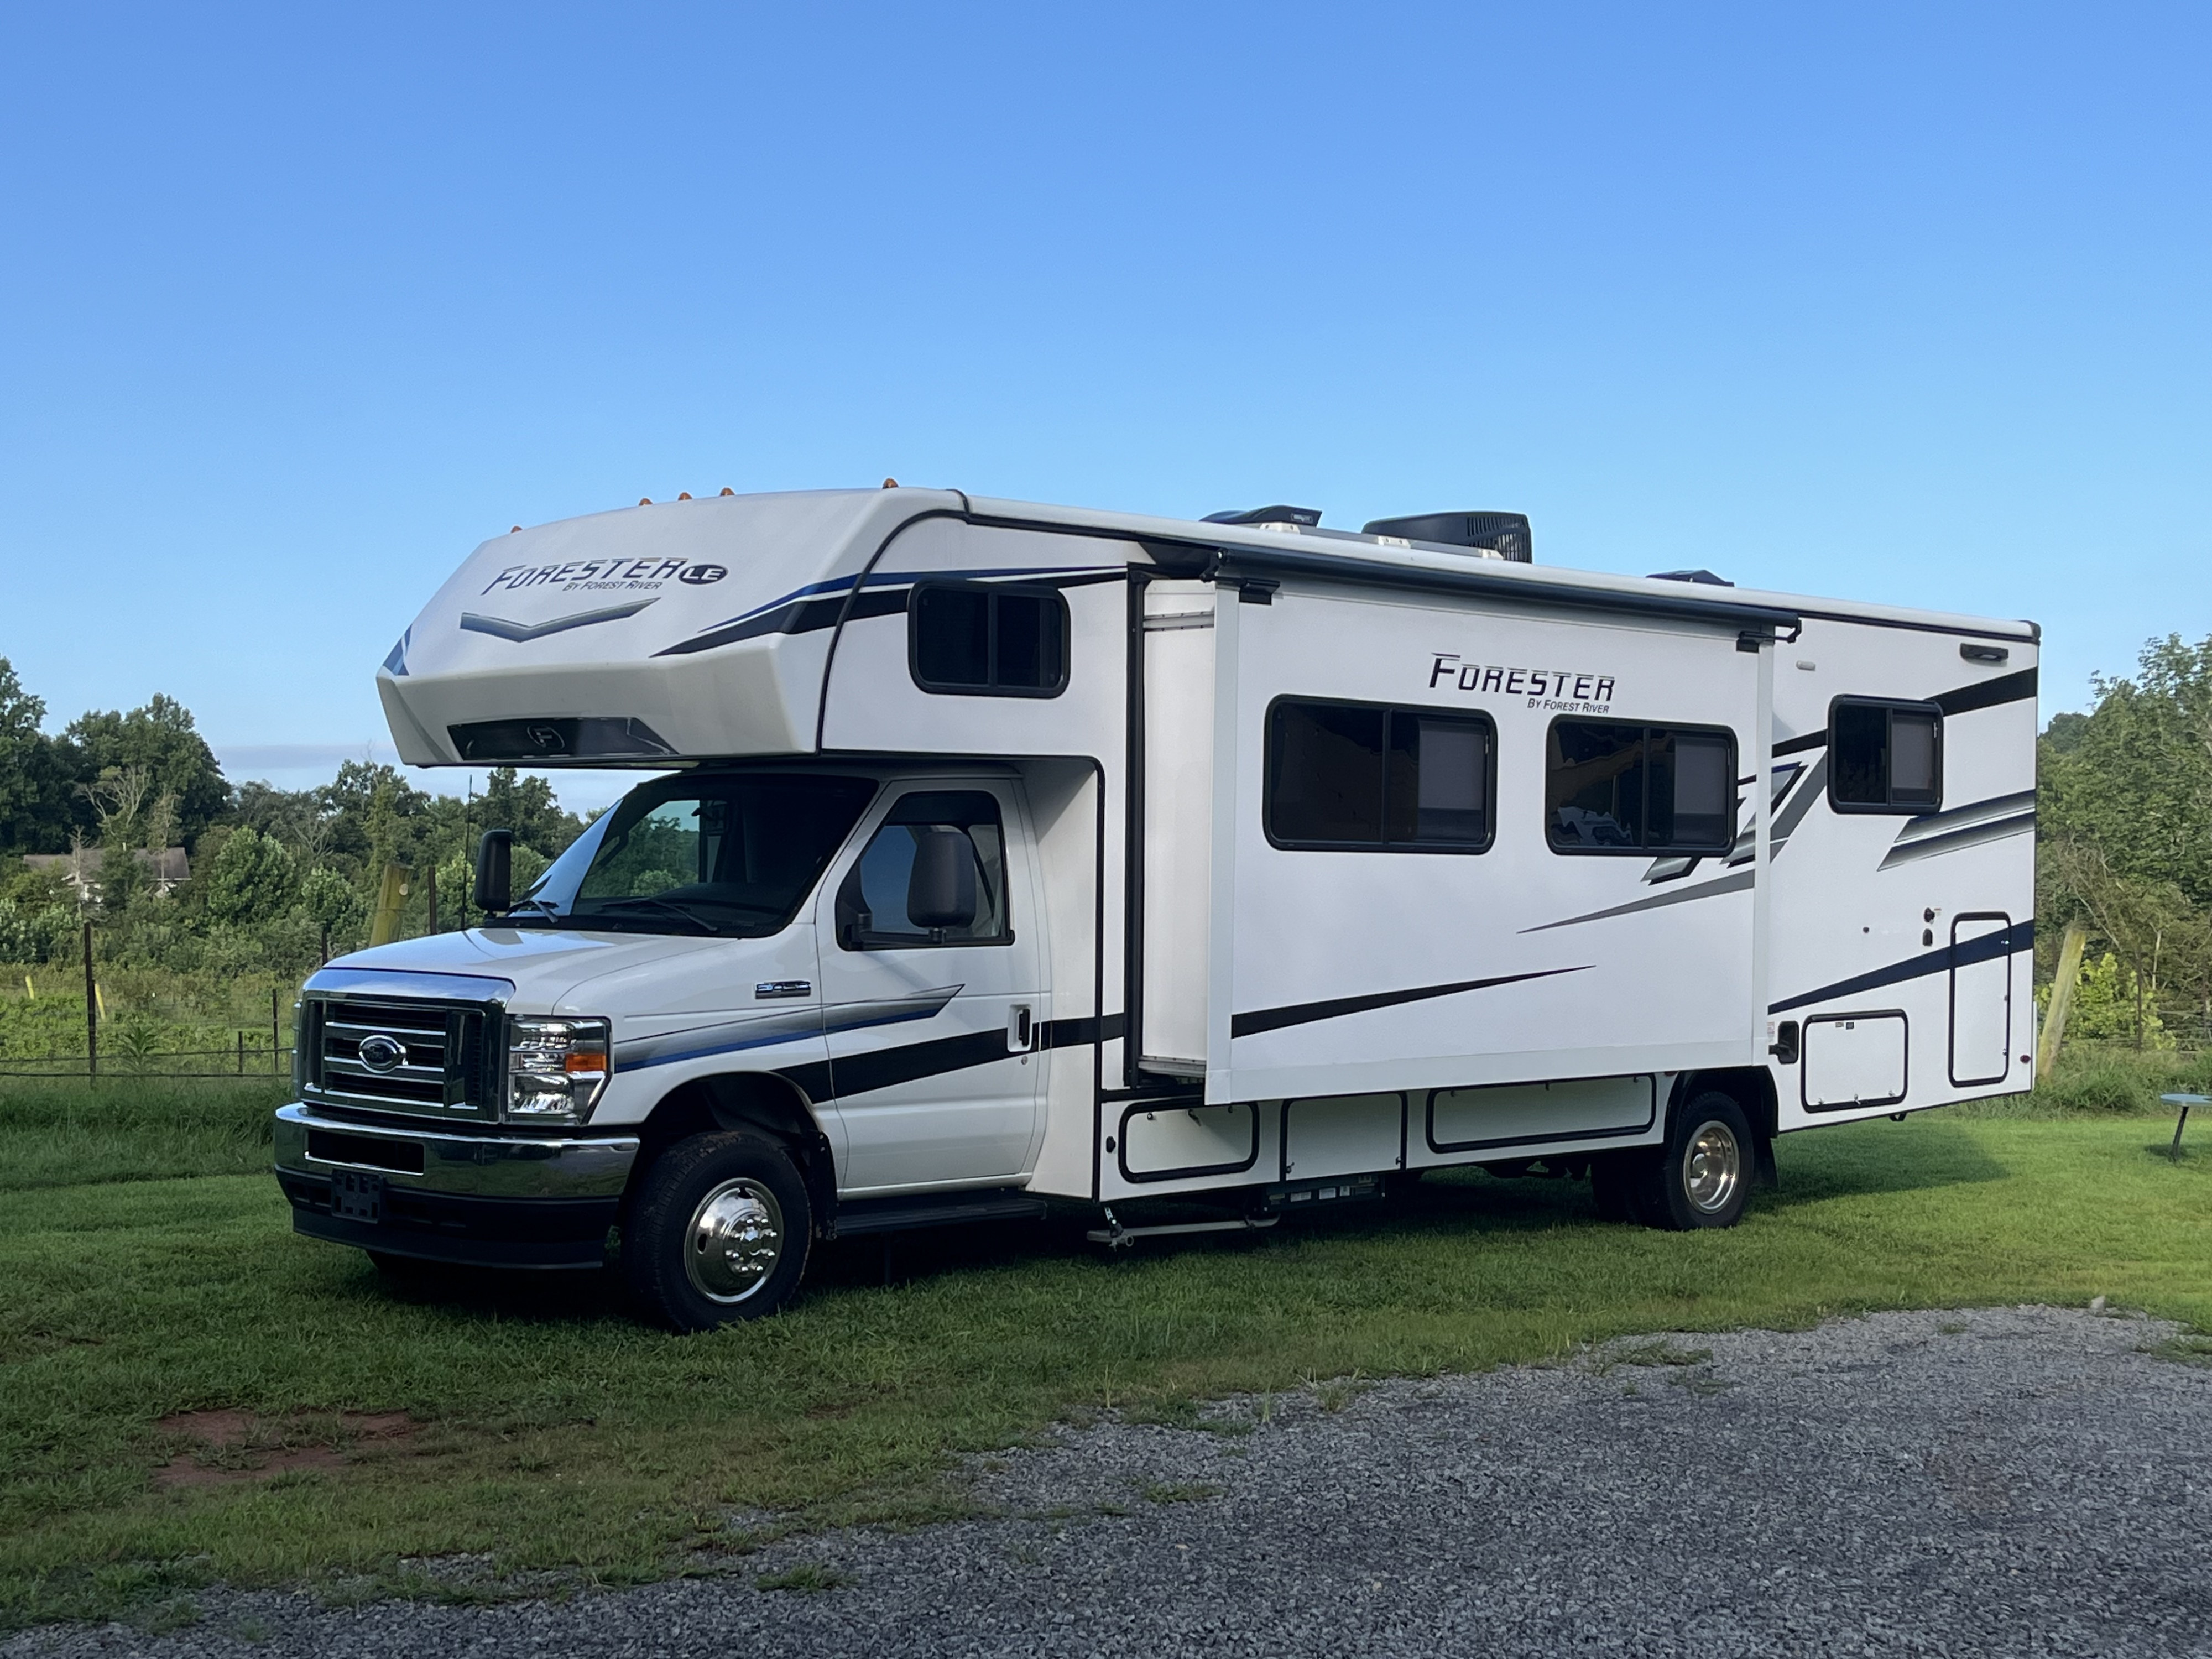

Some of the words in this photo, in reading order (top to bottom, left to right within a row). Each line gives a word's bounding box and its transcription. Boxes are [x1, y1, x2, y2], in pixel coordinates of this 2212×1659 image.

[481, 557, 689, 596] FORESTER
[682, 567, 722, 581] LE
[562, 582, 581, 591] BY
[580, 581, 627, 590] FOREST
[625, 581, 663, 589] RIVER
[1429, 653, 1615, 701] FORESTER
[1527, 698, 1541, 708] BY
[1543, 700, 1580, 712] FOREST
[1582, 702, 1609, 714] RIVER
